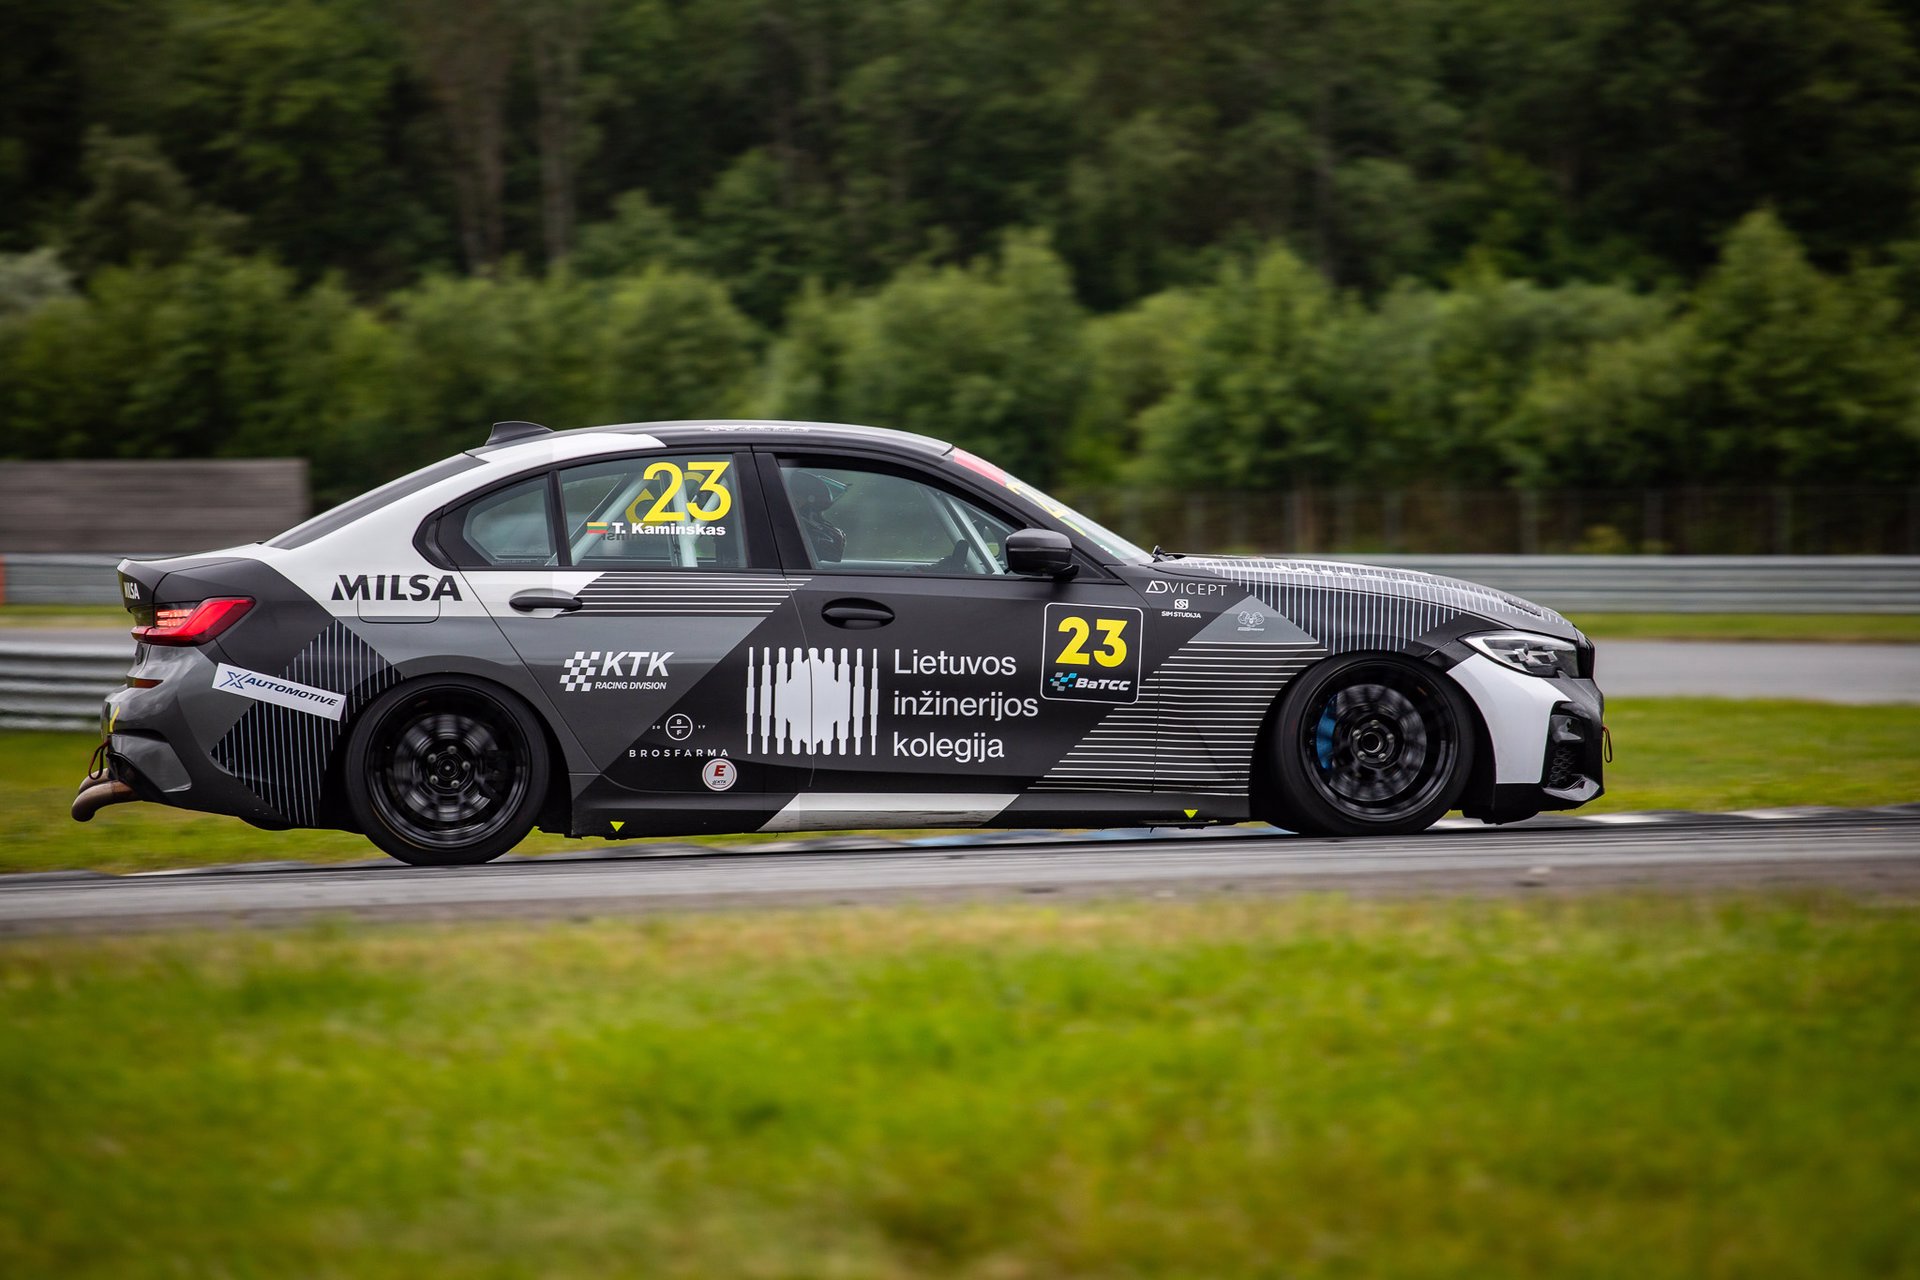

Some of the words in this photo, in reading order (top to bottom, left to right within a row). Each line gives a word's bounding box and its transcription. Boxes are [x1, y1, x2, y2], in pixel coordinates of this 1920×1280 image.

[643, 461, 732, 522] 23
[612, 522, 626, 534] T.
[631, 522, 726, 536] Kaminskas
[331, 574, 463, 601] MILSA
[1145, 580, 1228, 596] ADVICEPT
[1173, 611, 1202, 619] STUDIJA
[1055, 616, 1128, 668] 23
[601, 652, 674, 676] KTK
[894, 648, 1017, 676] Lietuvos
[594, 681, 628, 690] RACING
[629, 681, 667, 690] DIVISION
[1074, 677, 1131, 691] BaTCC
[893, 690, 1039, 721] inžinerijos
[629, 749, 729, 757] BROSFARMA
[893, 731, 1005, 763] kolegija
[714, 765, 726, 776] E
